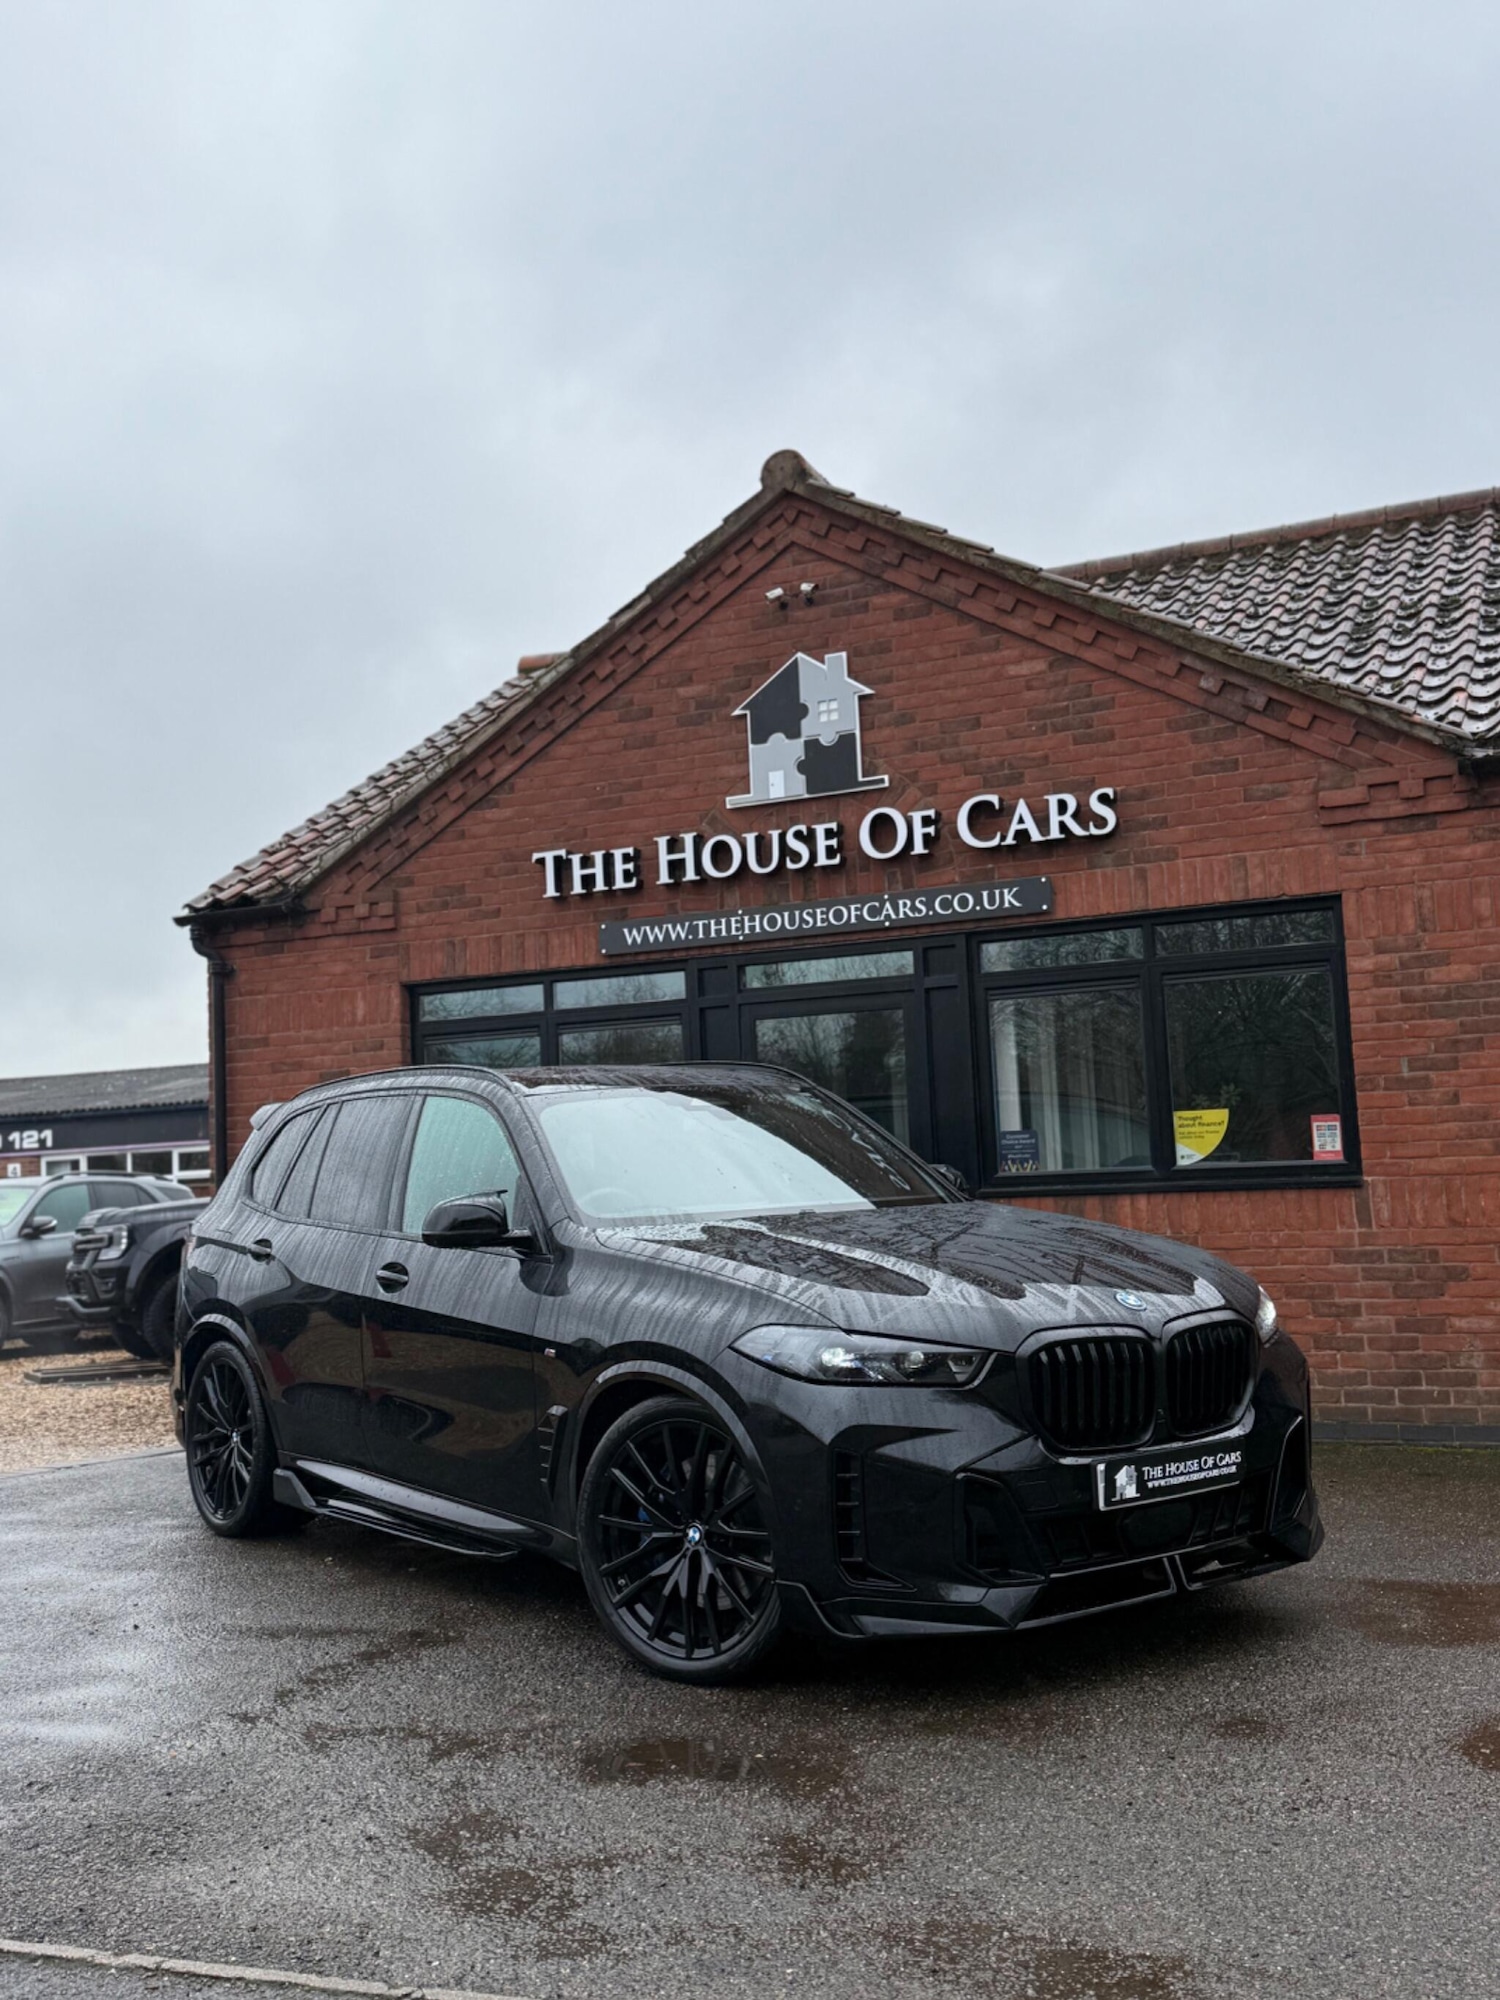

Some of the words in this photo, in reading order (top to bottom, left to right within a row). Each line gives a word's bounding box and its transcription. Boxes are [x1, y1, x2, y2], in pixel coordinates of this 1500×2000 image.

[532, 847, 637, 898] THE
[654, 822, 841, 886] HOUSE
[858, 806, 937, 861] OF
[956, 787, 1118, 849] CARS
[622, 886, 1022, 946] WWW.THEHOUSEOFCARS.CO.UK
[8, 1129, 52, 1149] 121
[1142, 1466, 1163, 1480] THE
[1165, 1459, 1199, 1476] HOUSE
[1201, 1456, 1215, 1469] OF
[1216, 1451, 1241, 1466] CARS
